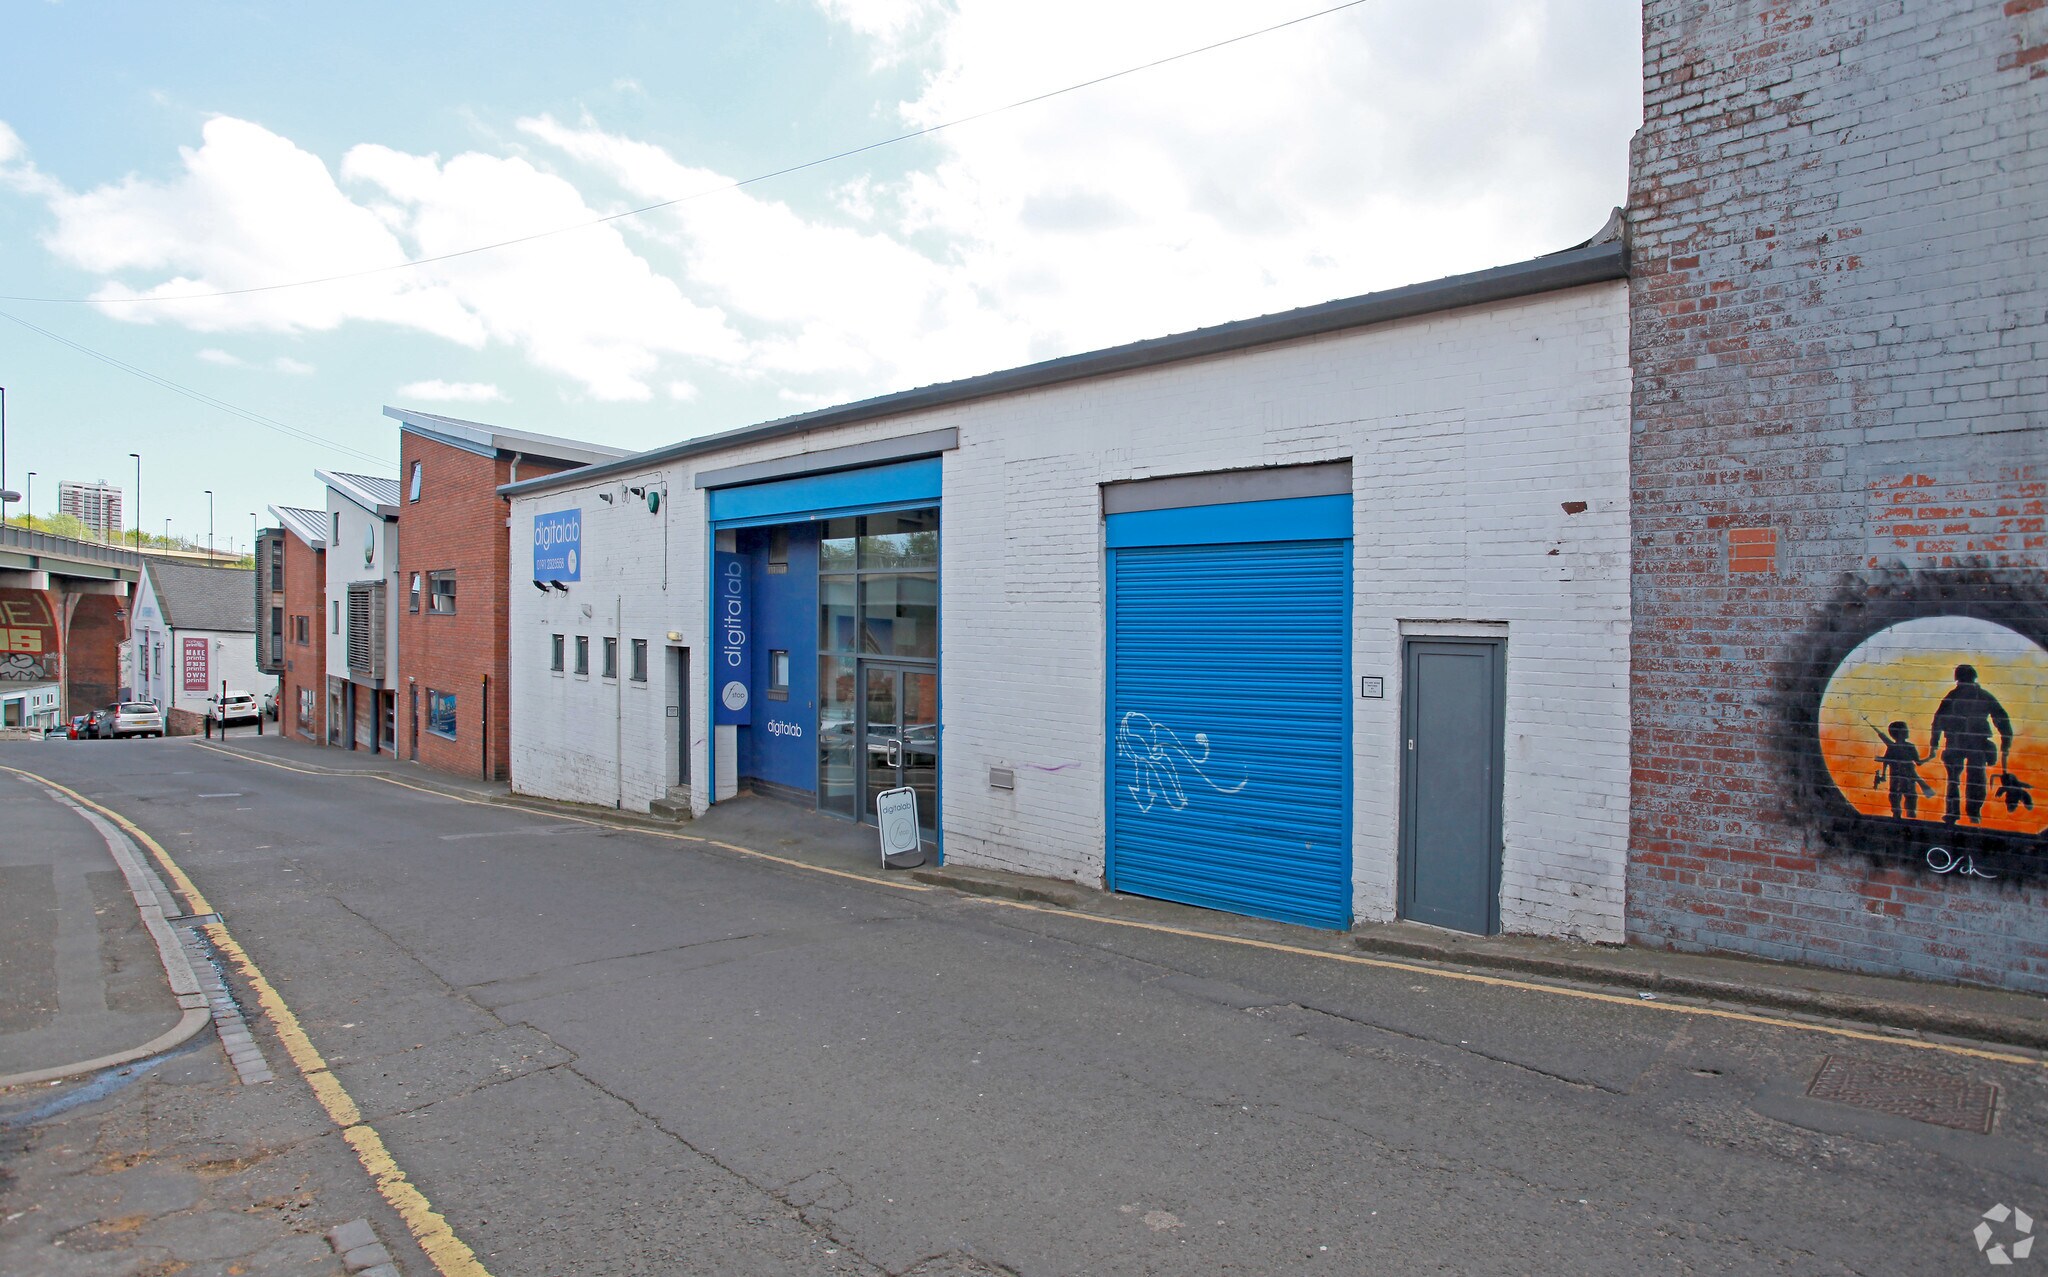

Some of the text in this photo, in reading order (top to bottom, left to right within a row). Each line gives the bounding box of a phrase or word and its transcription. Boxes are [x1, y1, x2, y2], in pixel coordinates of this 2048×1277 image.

[535, 517, 580, 550] digitalab
[724, 561, 745, 667] digitalab
[767, 719, 802, 738] digitalab
[883, 802, 912, 815] digitalab
